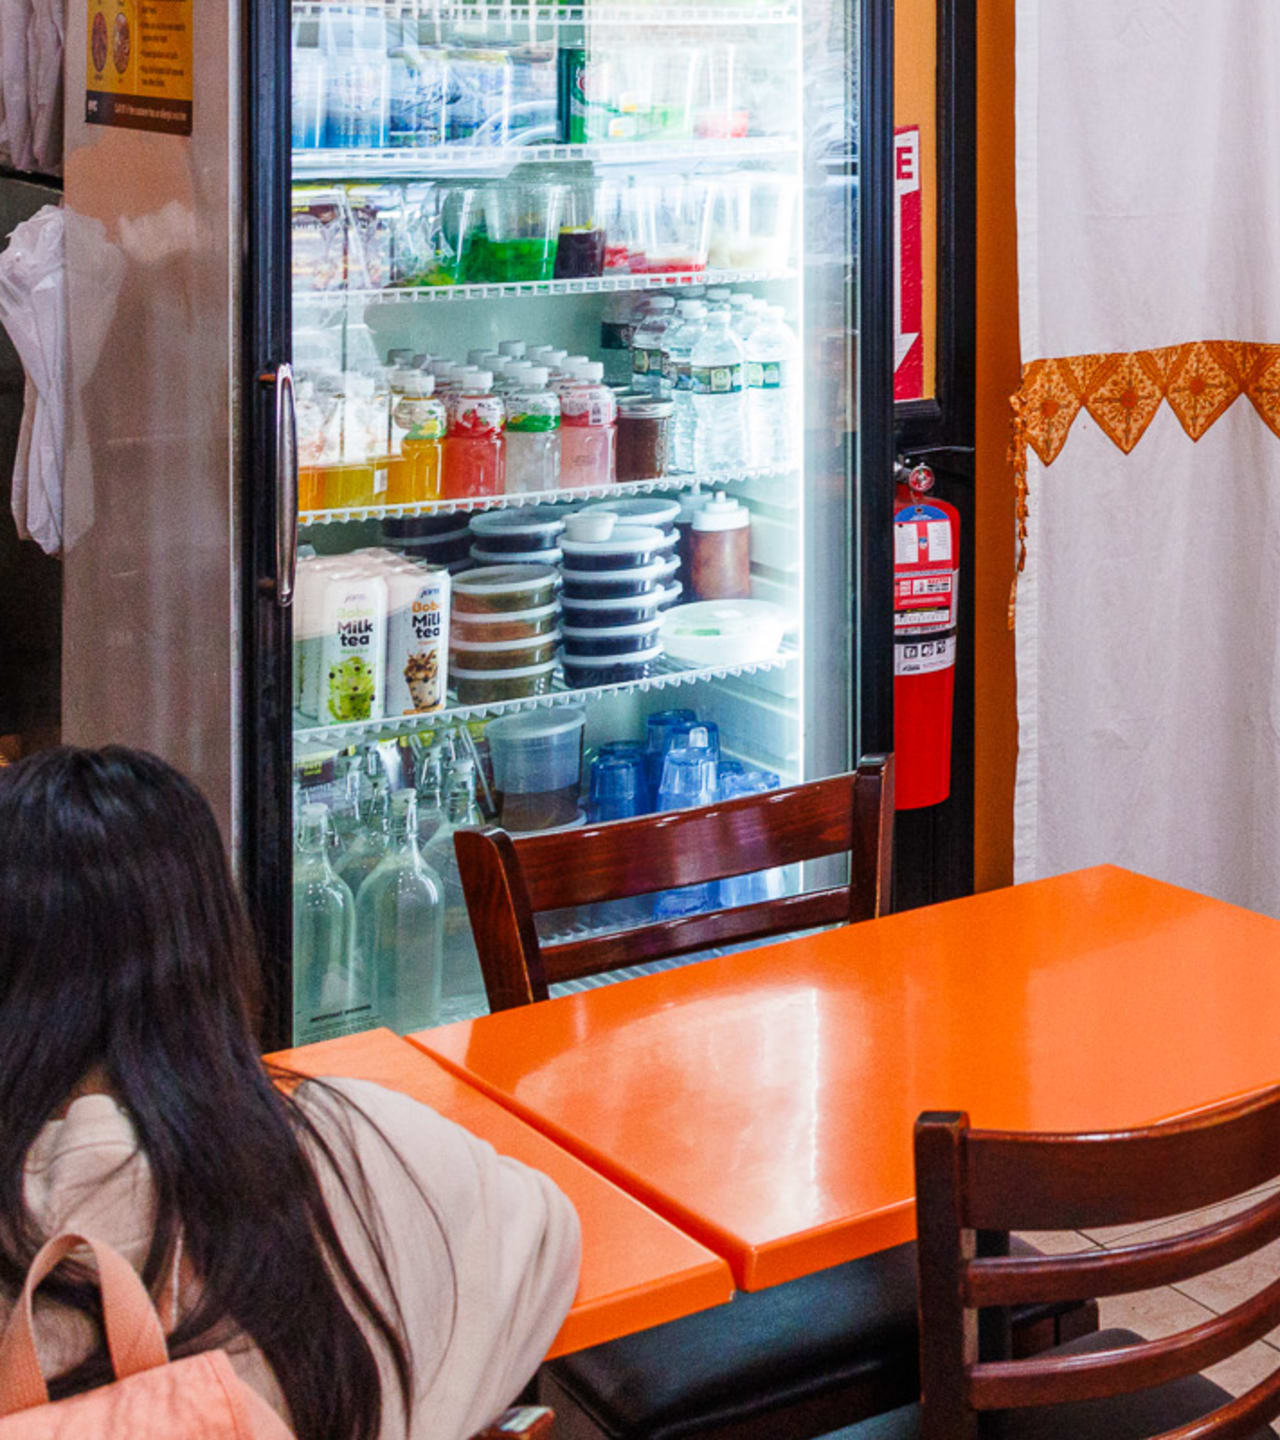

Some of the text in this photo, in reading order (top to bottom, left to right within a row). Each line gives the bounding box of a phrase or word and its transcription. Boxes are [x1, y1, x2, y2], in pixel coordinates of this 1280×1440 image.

[337, 618, 374, 635] Milk
[412, 612, 440, 628] Mil
[340, 633, 370, 647] tea
[415, 627, 441, 640] tea
